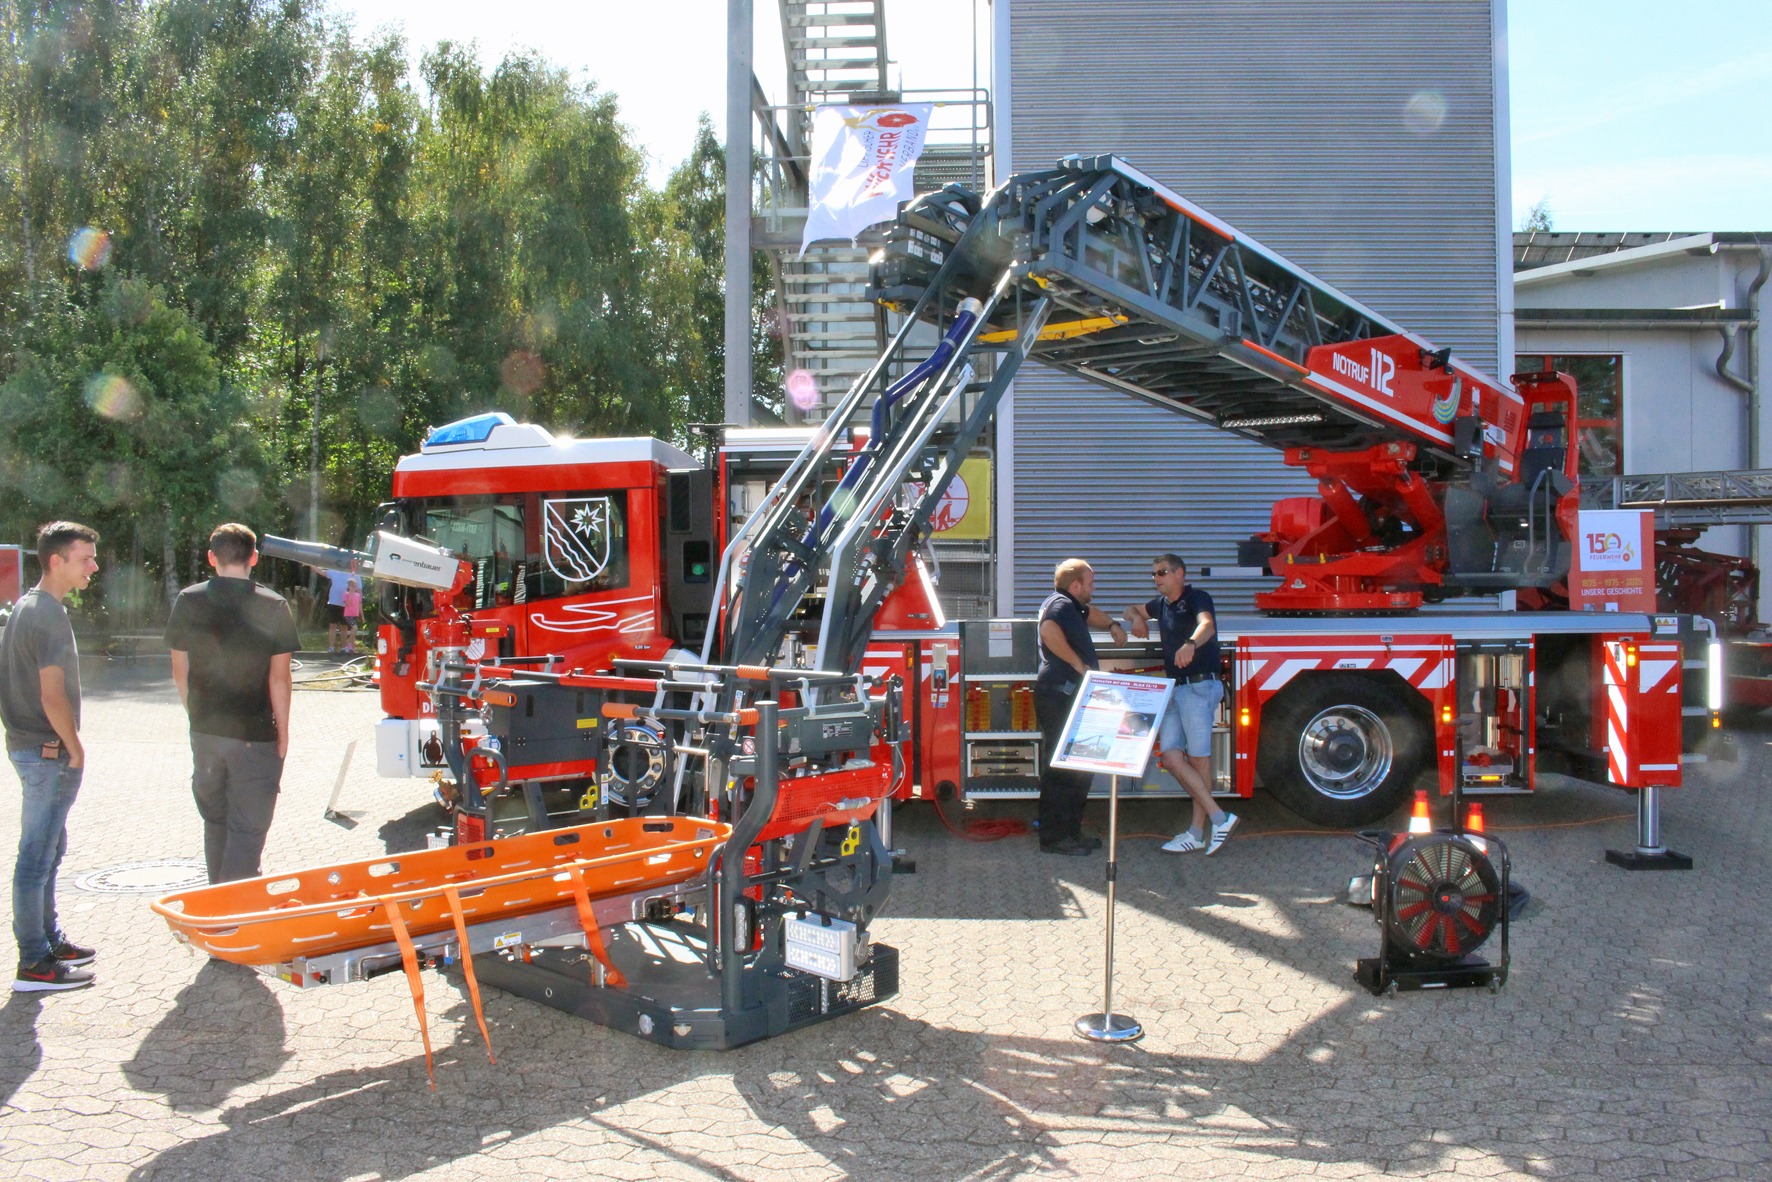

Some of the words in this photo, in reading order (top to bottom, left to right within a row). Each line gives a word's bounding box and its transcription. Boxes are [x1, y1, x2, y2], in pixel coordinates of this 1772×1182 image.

[1333, 352, 1369, 384] NOTRUF
[1371, 348, 1395, 397] 112
[1586, 533, 1622, 554] 150
[1625, 577, 1643, 586] 2025
[1581, 588, 1605, 596] UNSERE
[1606, 587, 1643, 596] GESCHICHTE
